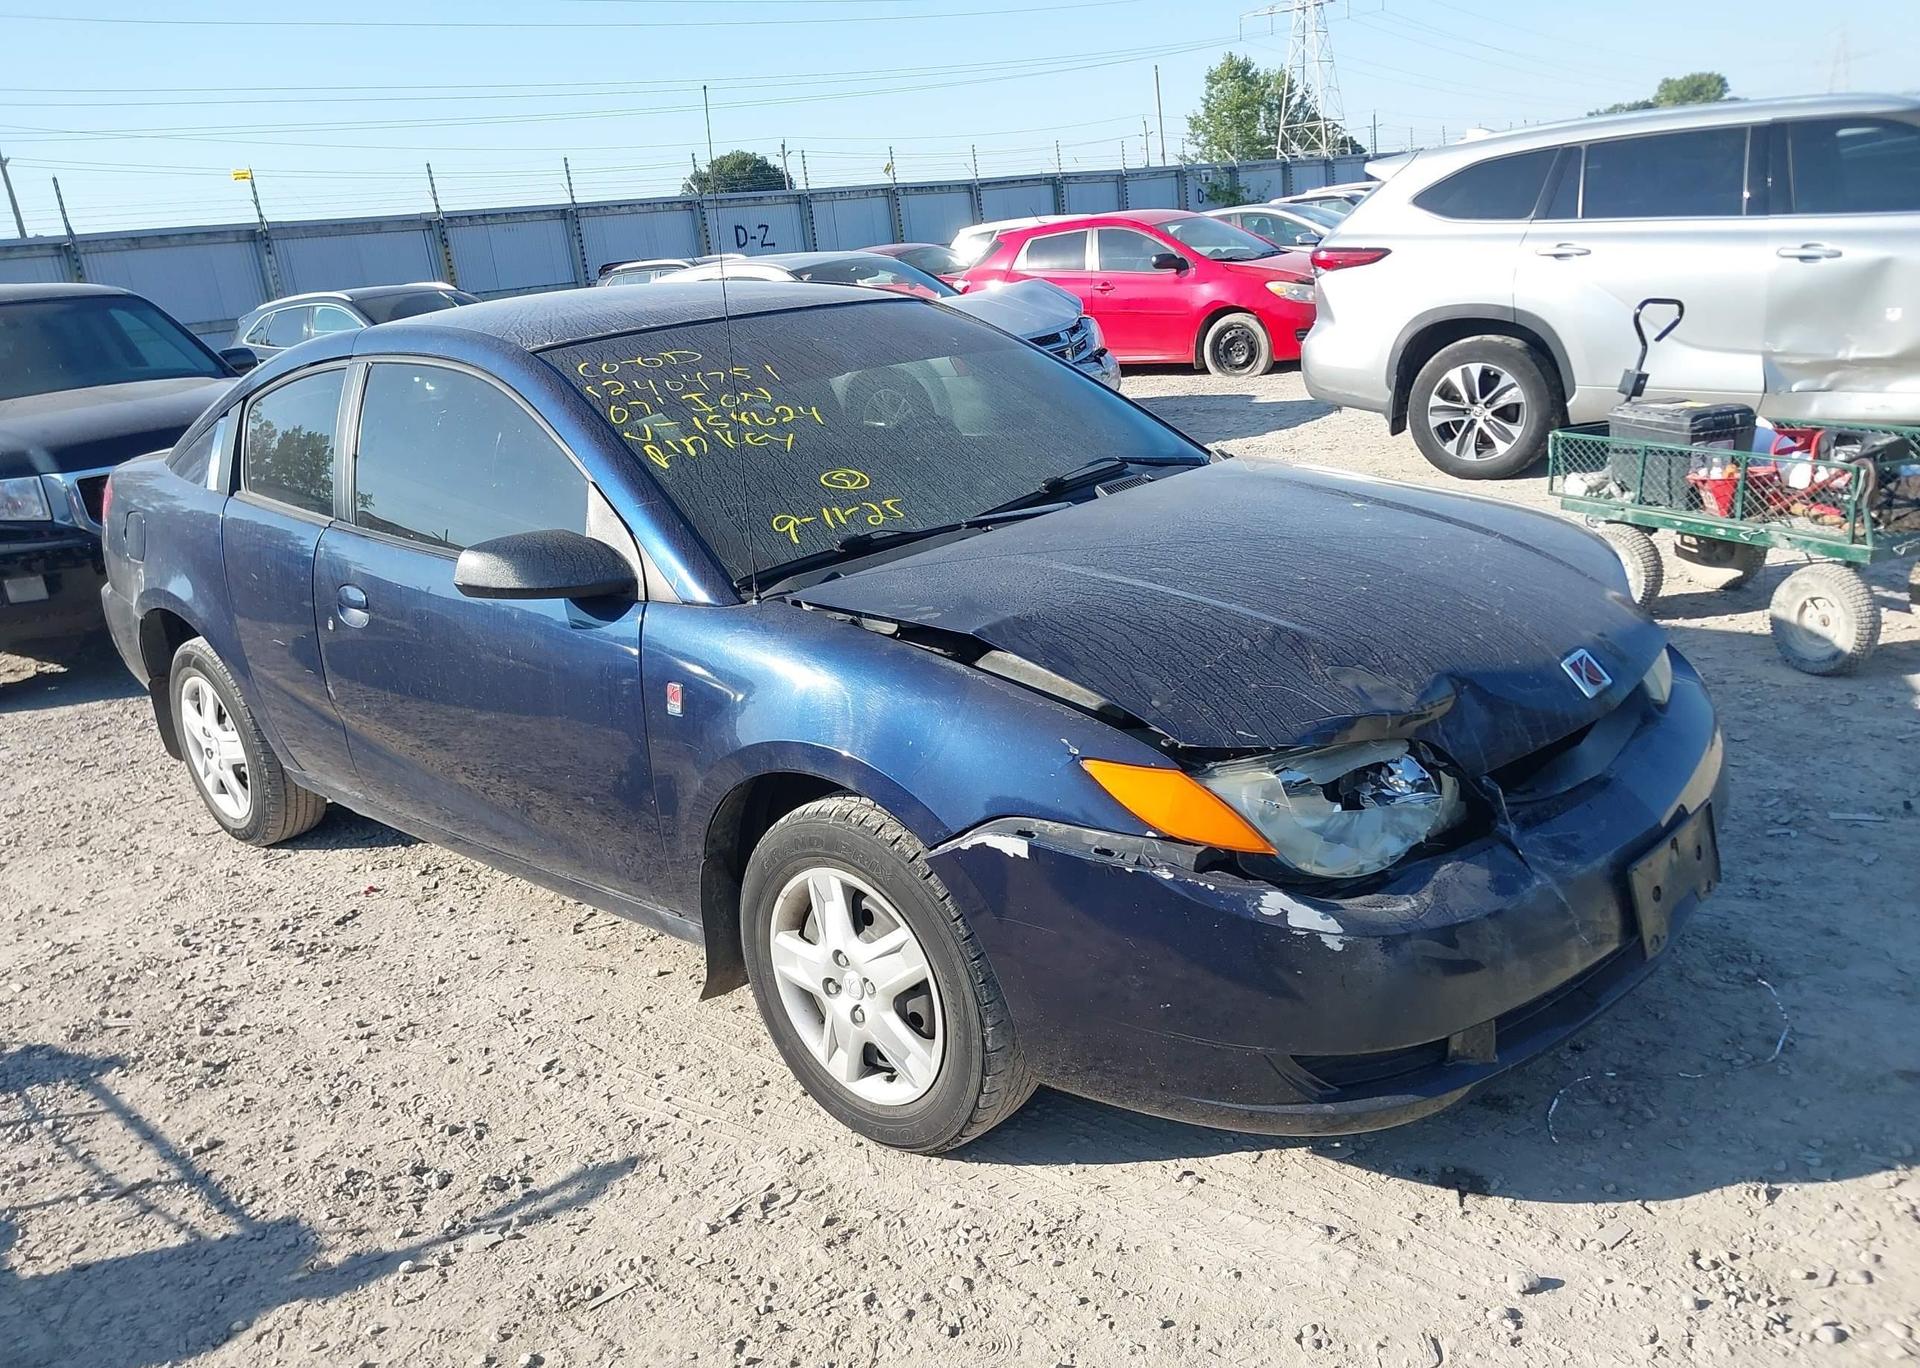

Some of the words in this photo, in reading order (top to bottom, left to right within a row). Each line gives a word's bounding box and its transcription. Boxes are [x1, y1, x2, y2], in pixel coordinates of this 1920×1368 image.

[682, 387, 772, 413] ION
[773, 499, 905, 544] 9-11-25
[760, 835, 825, 873] GRAND
[834, 840, 896, 885] PRIX
